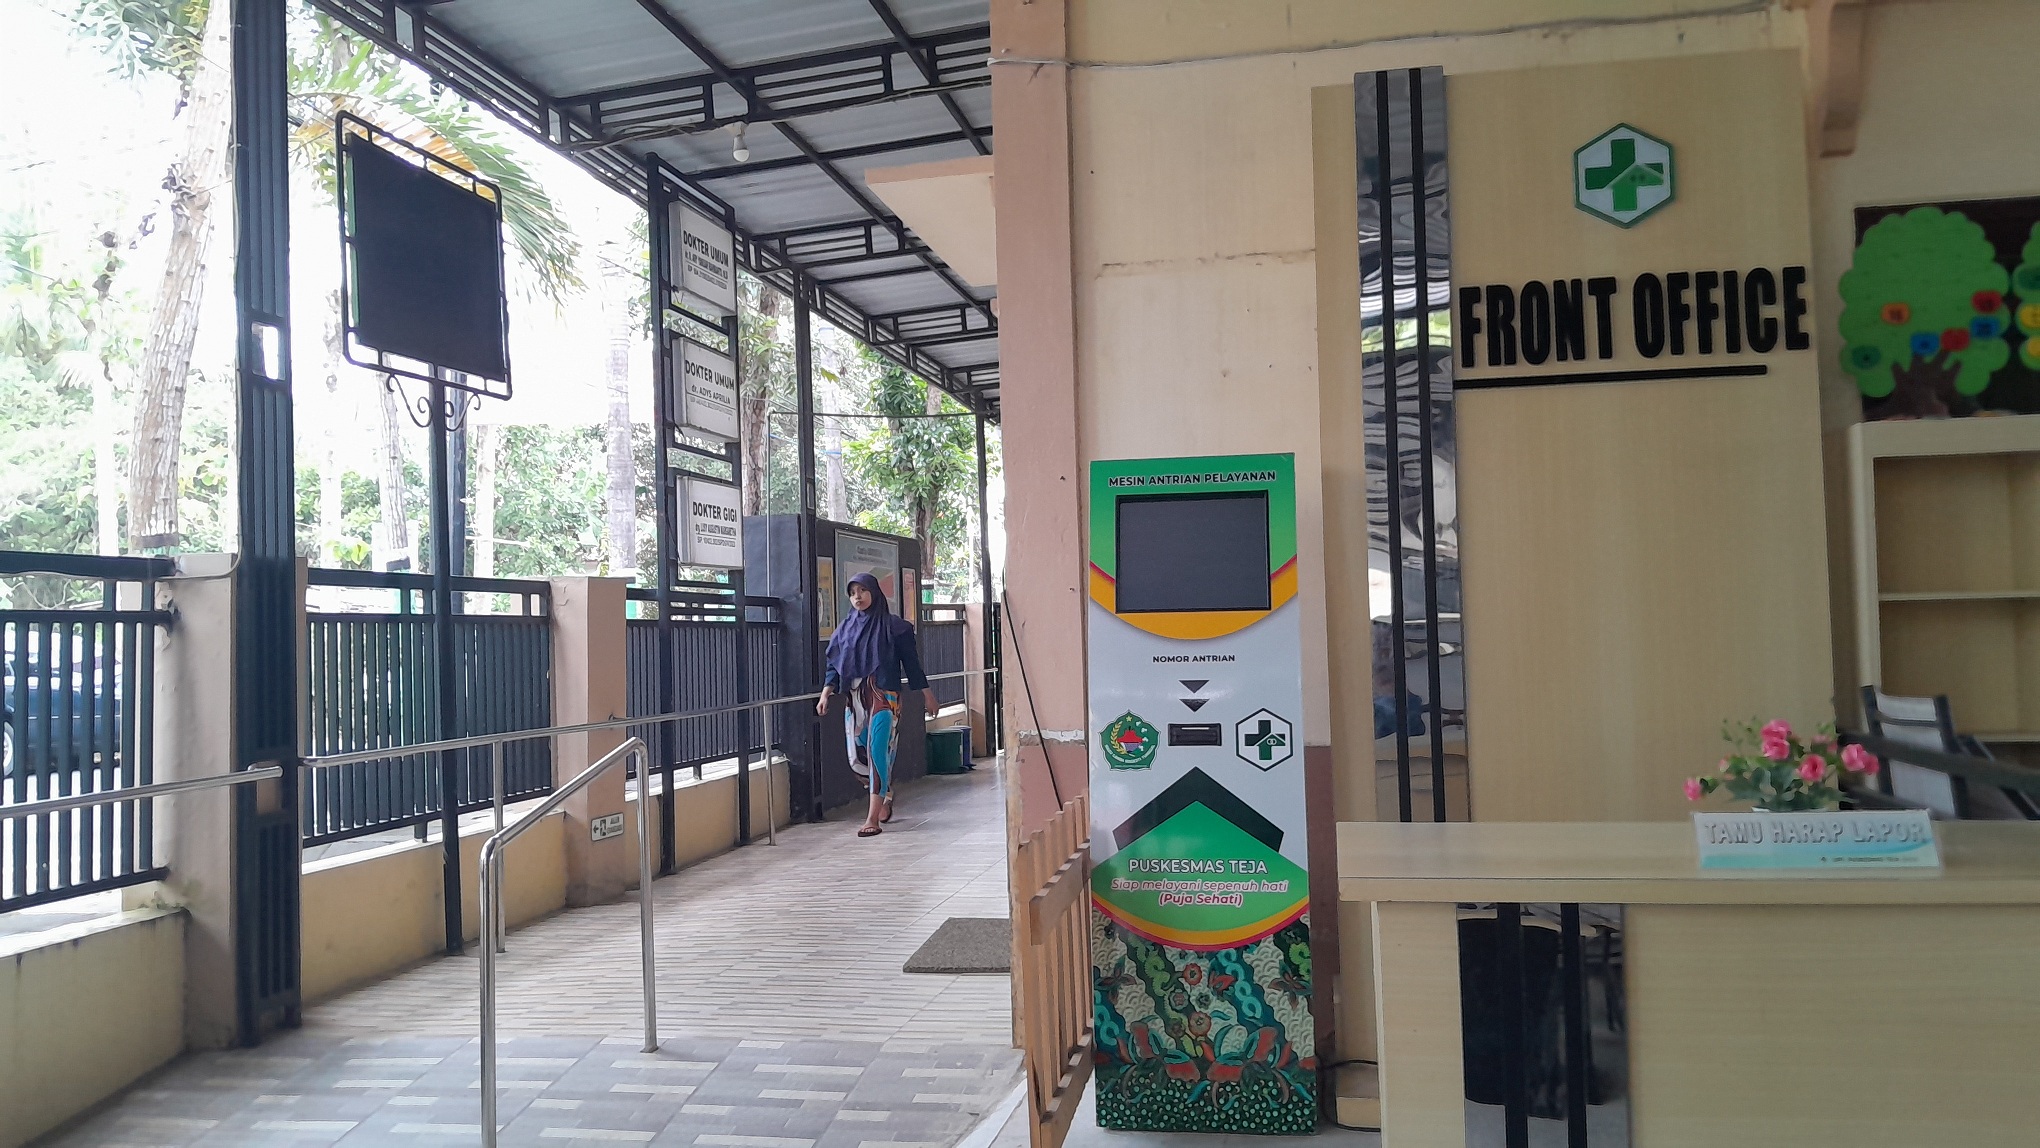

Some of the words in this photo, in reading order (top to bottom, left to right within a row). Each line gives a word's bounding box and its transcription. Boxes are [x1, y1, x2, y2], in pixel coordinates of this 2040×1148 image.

[683, 230, 709, 257] DOKTER
[710, 245, 728, 267] UMUM
[1459, 276, 1617, 368] FRONT
[1633, 266, 1810, 358] OFFICE
[685, 359, 713, 383] DOKTER
[714, 371, 735, 391] UMUM
[1108, 475, 1145, 487] MESIN
[1148, 474, 1201, 486] ANTRIAN
[1204, 471, 1276, 484] PELAYANAN
[692, 501, 721, 520] DOKTER
[723, 507, 737, 523] GIGI
[1152, 655, 1190, 664] NOMOR
[1192, 654, 1236, 663] ANTRIAN
[1705, 822, 1765, 845] TAMU
[1771, 821, 1844, 845] HARAP
[1852, 821, 1927, 844] LAPOR
[1129, 859, 1225, 873] PUSKESMAS
[1228, 860, 1268, 873] TEJA
[1111, 878, 1140, 892] Siap
[1142, 878, 1202, 892] melayani
[1203, 880, 1258, 893] sepenuh
[1261, 880, 1289, 892] hati
[1159, 892, 1193, 906] (Puja
[1196, 893, 1243, 907] Sehati)
